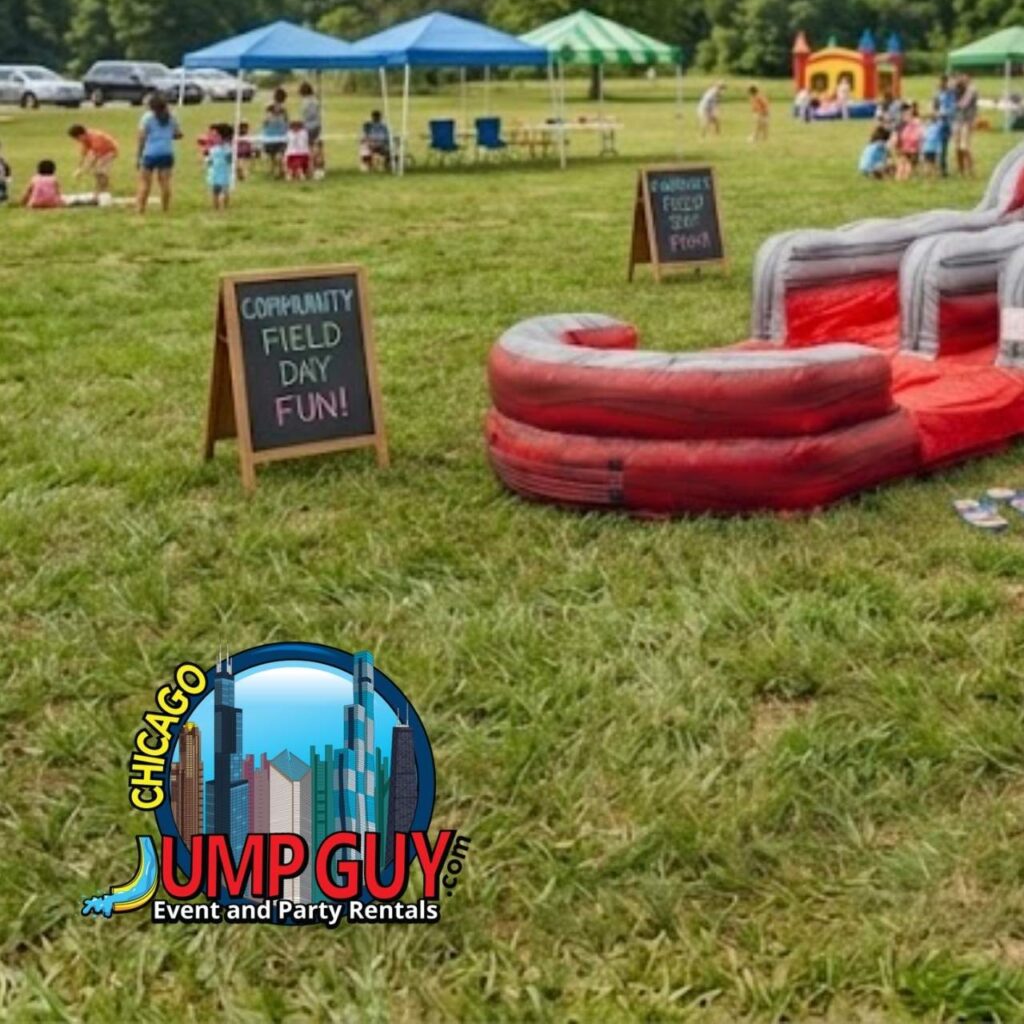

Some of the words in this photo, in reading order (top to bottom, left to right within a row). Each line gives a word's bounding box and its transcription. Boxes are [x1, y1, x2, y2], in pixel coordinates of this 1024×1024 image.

[243, 291, 352, 318] COMMUNITY
[263, 322, 340, 355] FIELD
[279, 355, 331, 387] DAY
[276, 386, 349, 426] FUN!
